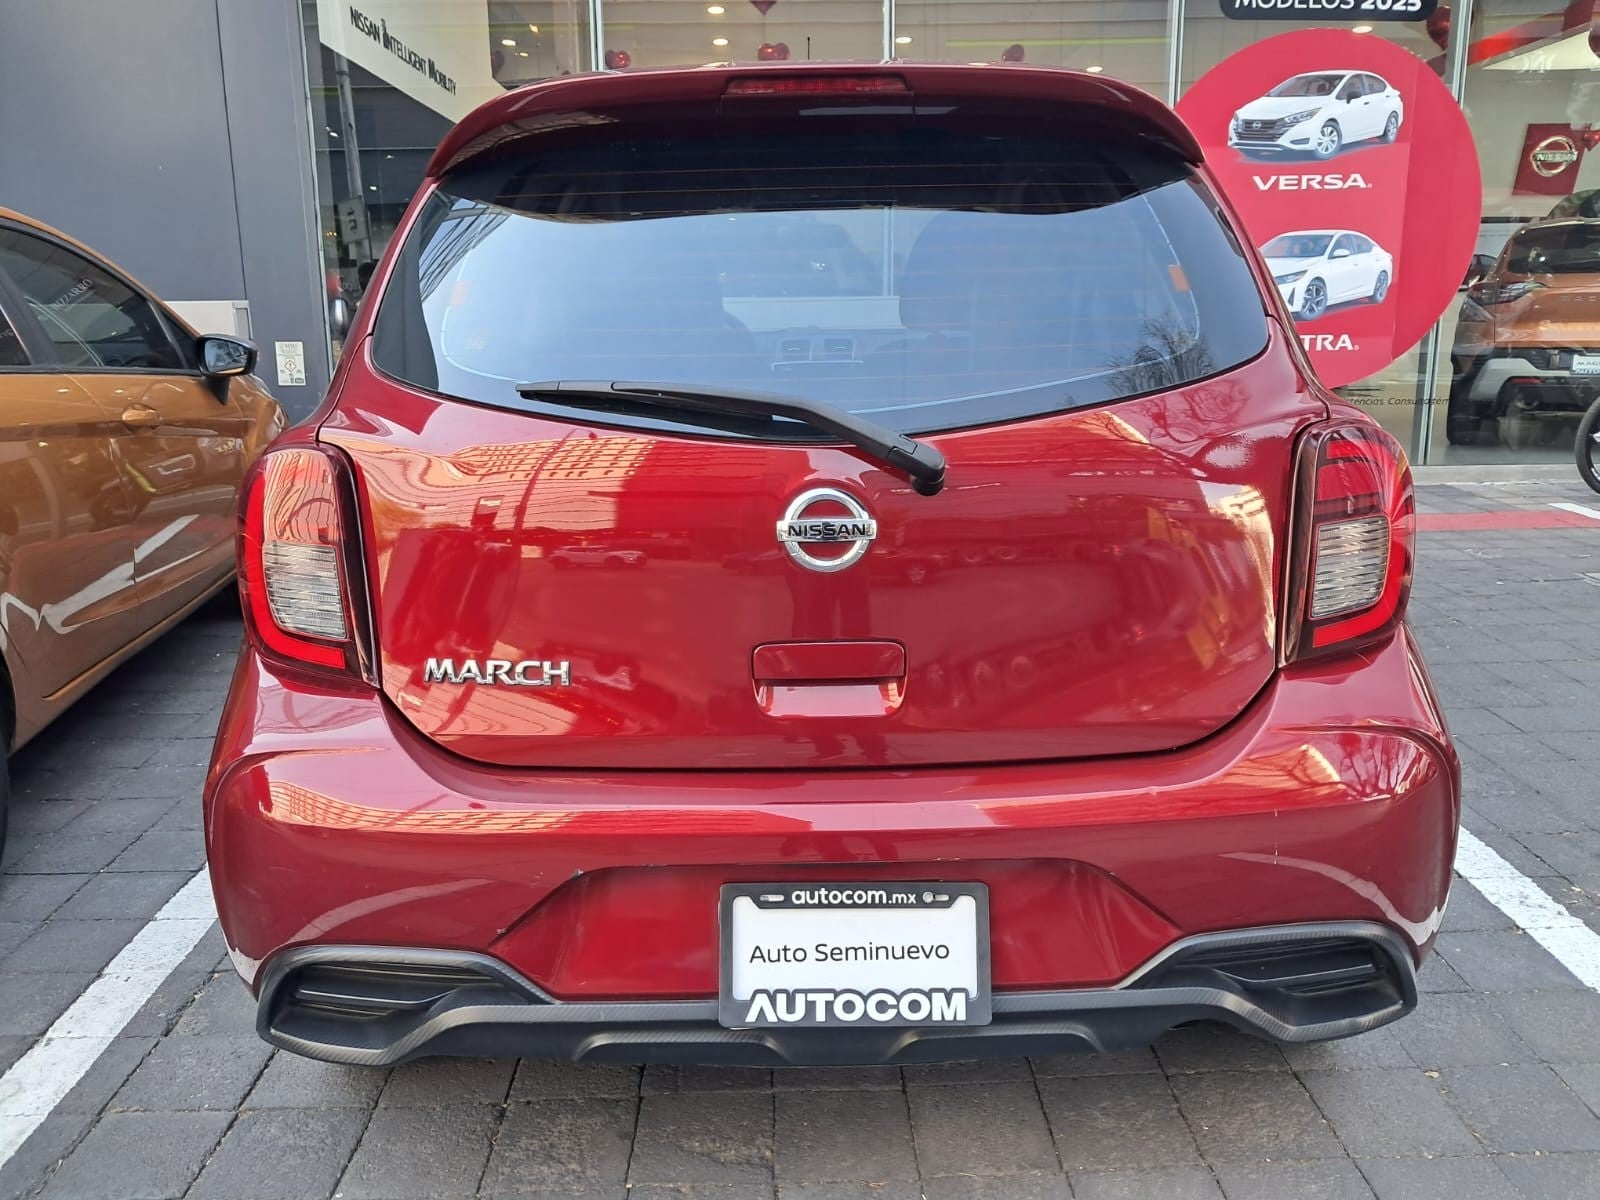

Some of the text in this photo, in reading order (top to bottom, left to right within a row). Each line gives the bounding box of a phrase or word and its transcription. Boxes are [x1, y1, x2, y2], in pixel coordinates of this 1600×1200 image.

[350, 6, 457, 96] NISSAN INTELLIGENT MOBILITY
[1252, 173, 1367, 190] VERSA
[1300, 334, 1354, 351] TRA
[787, 523, 867, 537] NISSAN
[424, 657, 570, 686] MARCH
[791, 887, 917, 905] autocom.mx
[749, 942, 950, 964] Auto Seminuevo
[745, 991, 967, 1023] AUTOCOM
